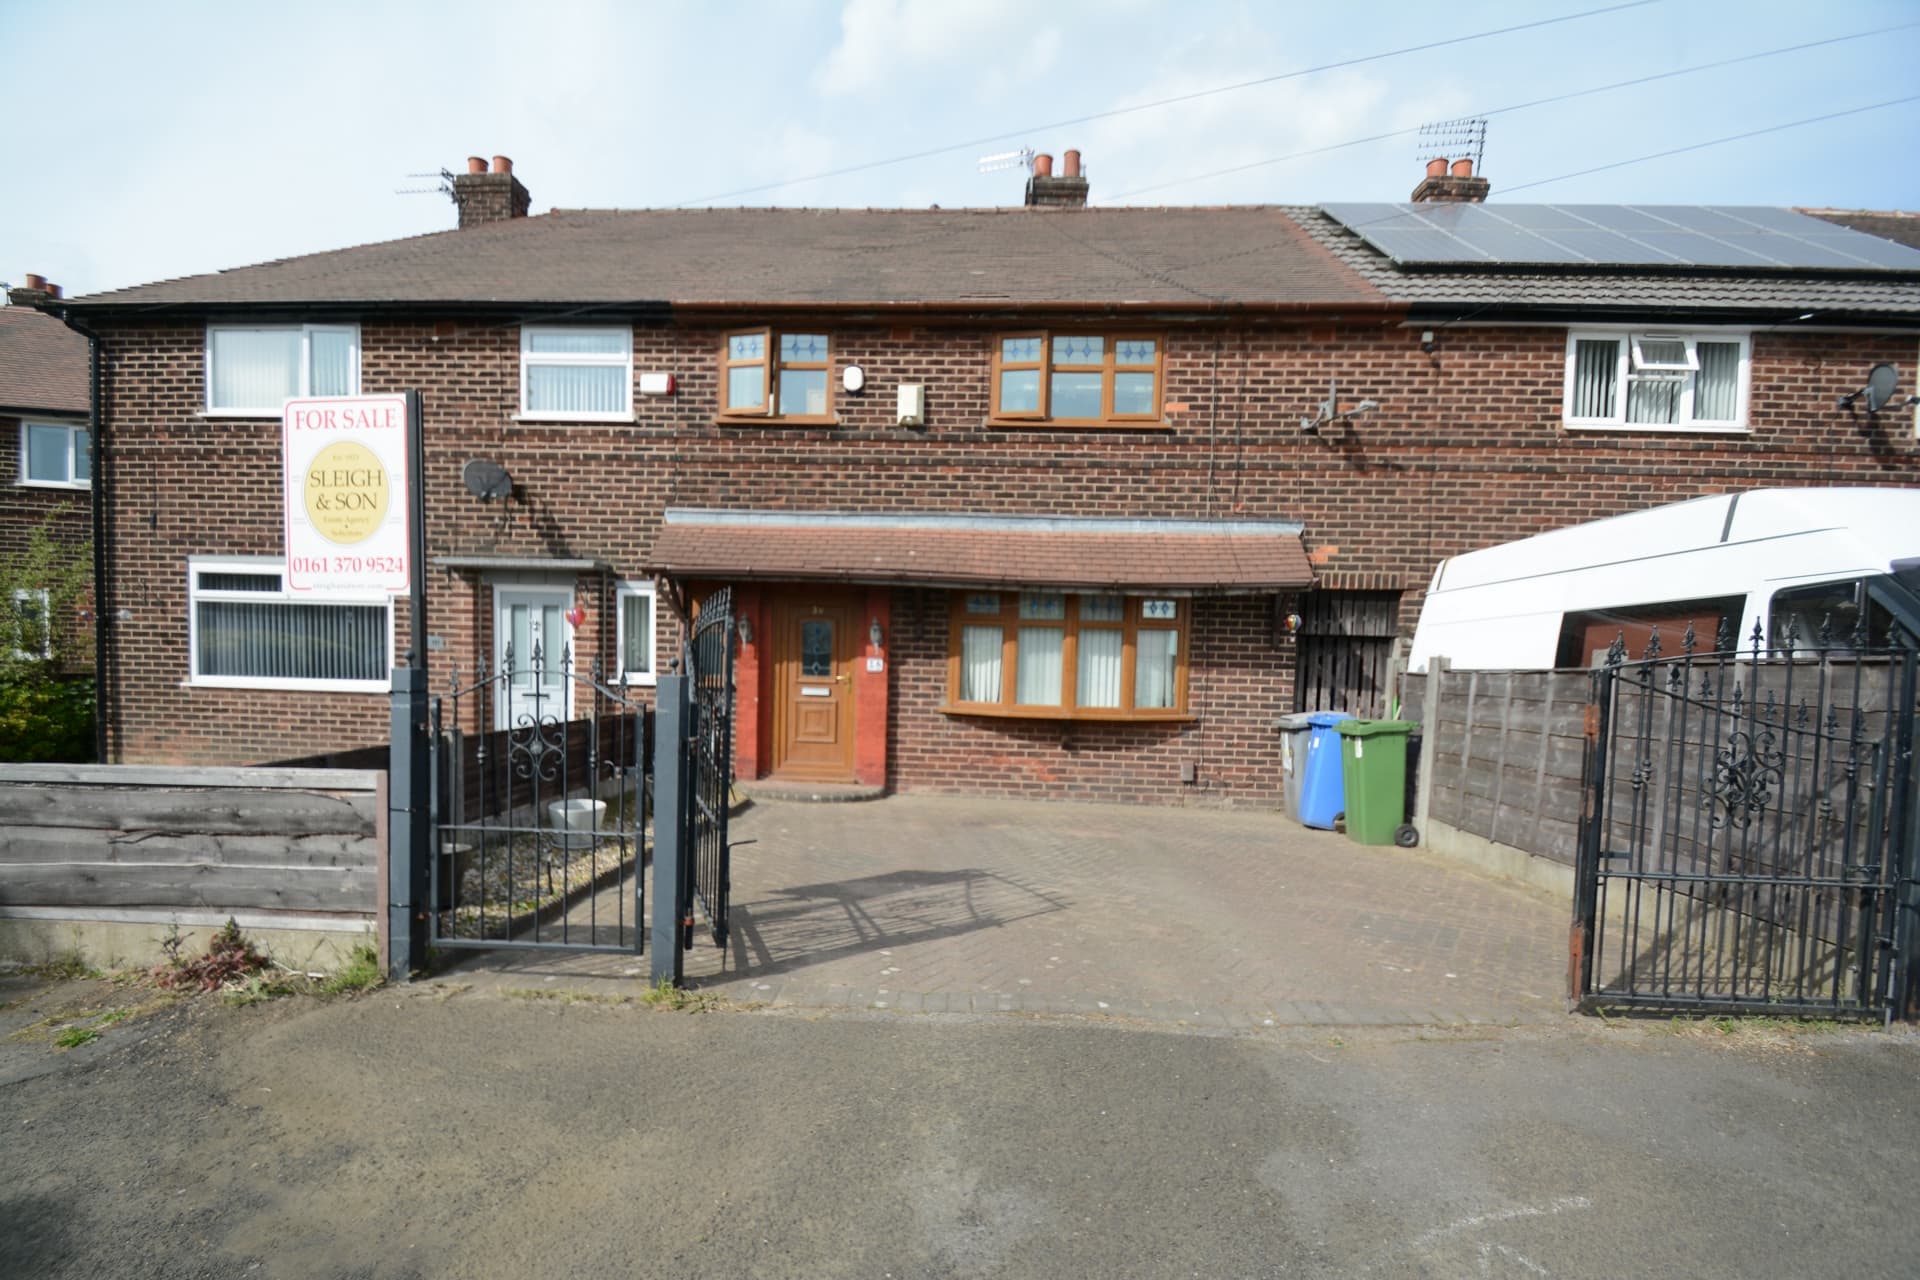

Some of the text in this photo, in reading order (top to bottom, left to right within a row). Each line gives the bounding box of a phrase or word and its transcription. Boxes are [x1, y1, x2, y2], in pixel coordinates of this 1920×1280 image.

[295, 408, 397, 430] FOR SALE
[310, 469, 382, 488] SLEIGH
[316, 492, 377, 511] & SON
[293, 555, 404, 574] 0161 370 9524
